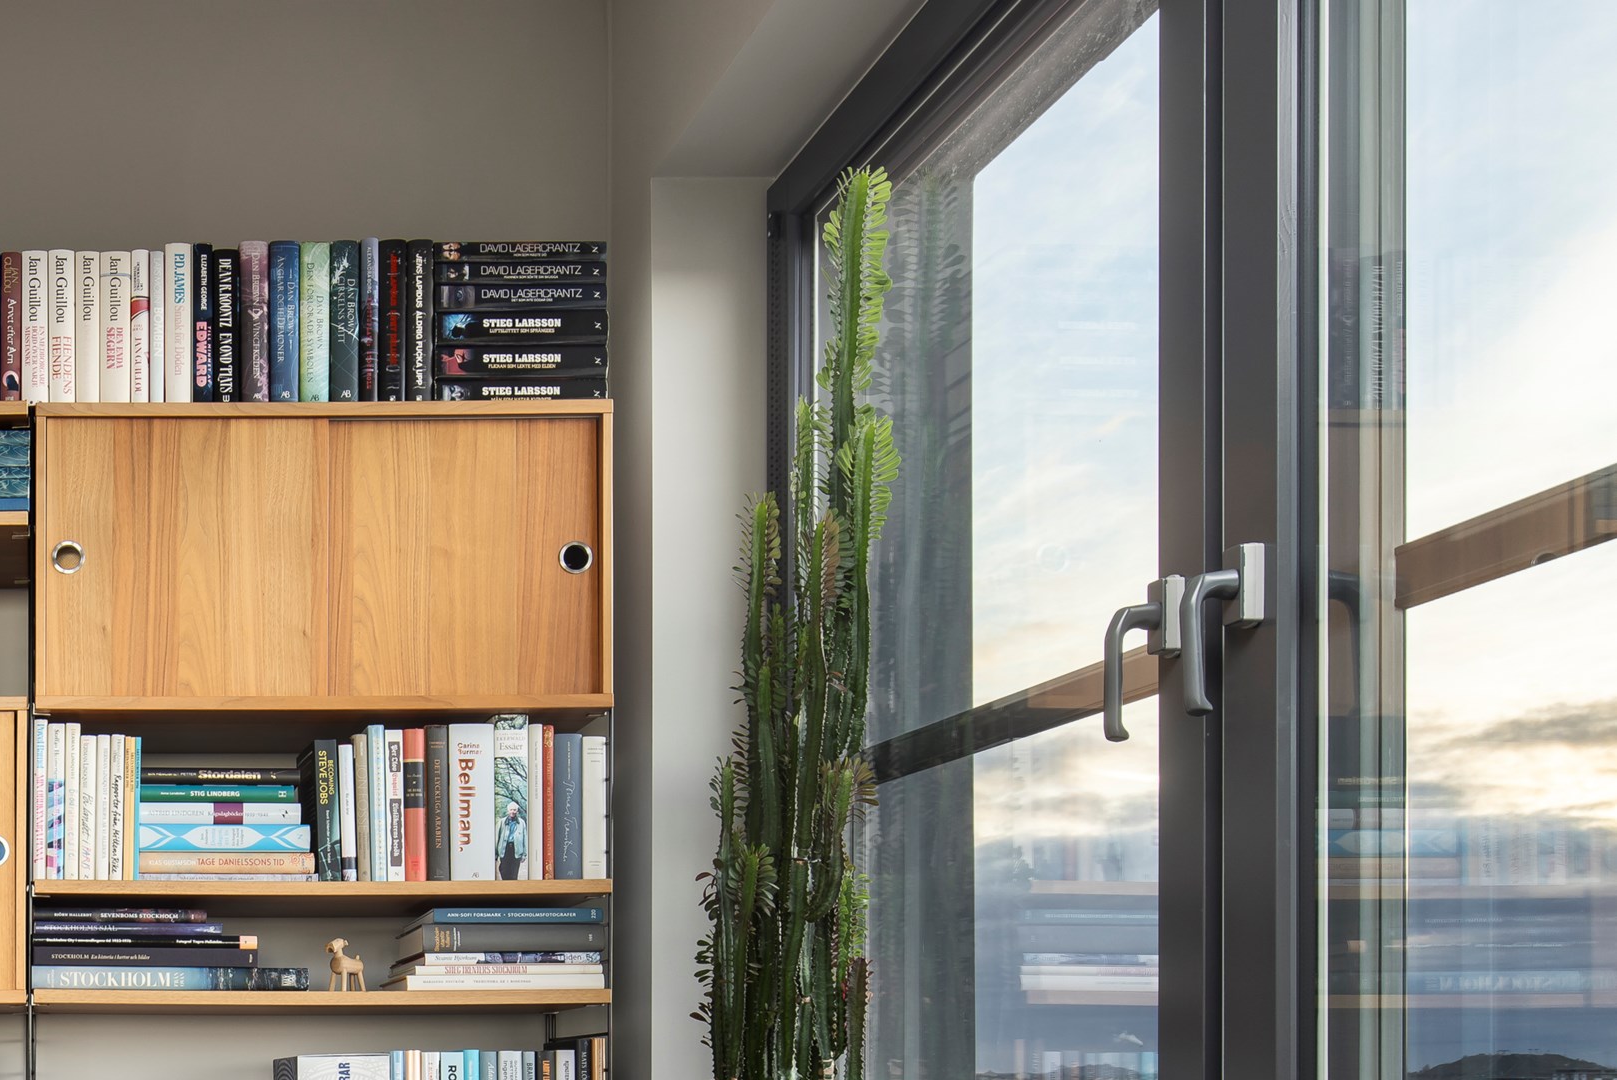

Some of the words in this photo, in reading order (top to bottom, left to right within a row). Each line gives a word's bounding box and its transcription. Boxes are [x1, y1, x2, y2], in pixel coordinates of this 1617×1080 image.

[479, 243, 508, 253] DAVID
[509, 243, 581, 253] LAGERCRANTZ
[28, 256, 40, 275] Jan
[55, 255, 67, 275] Jan
[83, 255, 94, 274] Jan
[110, 256, 121, 274] Jan
[174, 253, 185, 270] P.D.
[480, 266, 509, 275] DAVID
[510, 266, 582, 275] LAGERCRANTZ
[82, 276, 95, 321] Guillou
[174, 271, 185, 304] JAMES
[481, 289, 510, 298] DAVID
[511, 289, 583, 298] LAGERCRANTZ
[28, 278, 41, 322] Guillou
[55, 277, 68, 323] Guillou
[109, 277, 122, 321] Guillou
[174, 305, 185, 330] Smak
[482, 319, 513, 327] STIEG
[514, 319, 561, 327] LARSSON
[52, 336, 61, 380] FIENDE
[106, 327, 115, 369] SEGERN
[196, 321, 207, 387] EDWARD
[482, 354, 513, 362] STIEG
[514, 354, 561, 362] LARSSON
[63, 336, 72, 394] FIENDENS
[175, 346, 185, 375] Döden
[482, 387, 512, 395] STIEG
[514, 387, 560, 395] LARSSON
[499, 742, 523, 751] Essäer
[198, 770, 261, 780] Stordalen
[318, 750, 328, 780] STEVE
[319, 780, 329, 805] JOBS
[457, 758, 475, 853] Bellman.
[59, 971, 170, 987] STOCKHOLM
